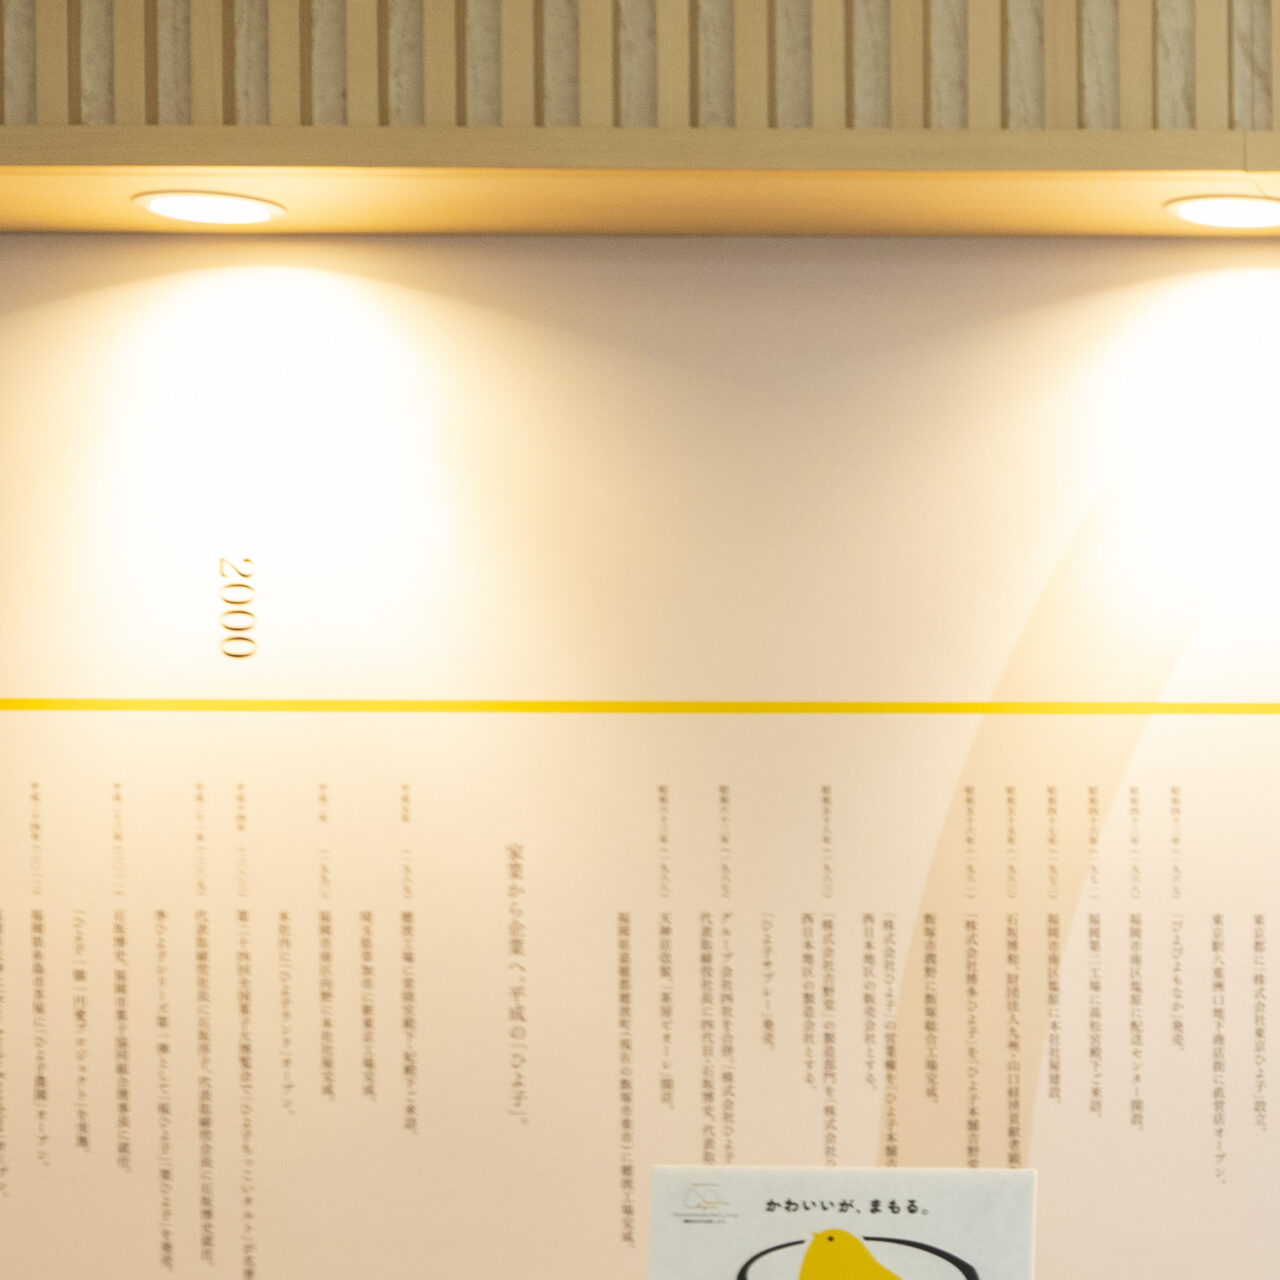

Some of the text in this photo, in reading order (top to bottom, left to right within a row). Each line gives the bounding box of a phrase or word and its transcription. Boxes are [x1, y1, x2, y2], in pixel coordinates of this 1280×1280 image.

[219, 556, 258, 660] 2000
[765, 1198, 930, 1216] かわいいが、まもる。
